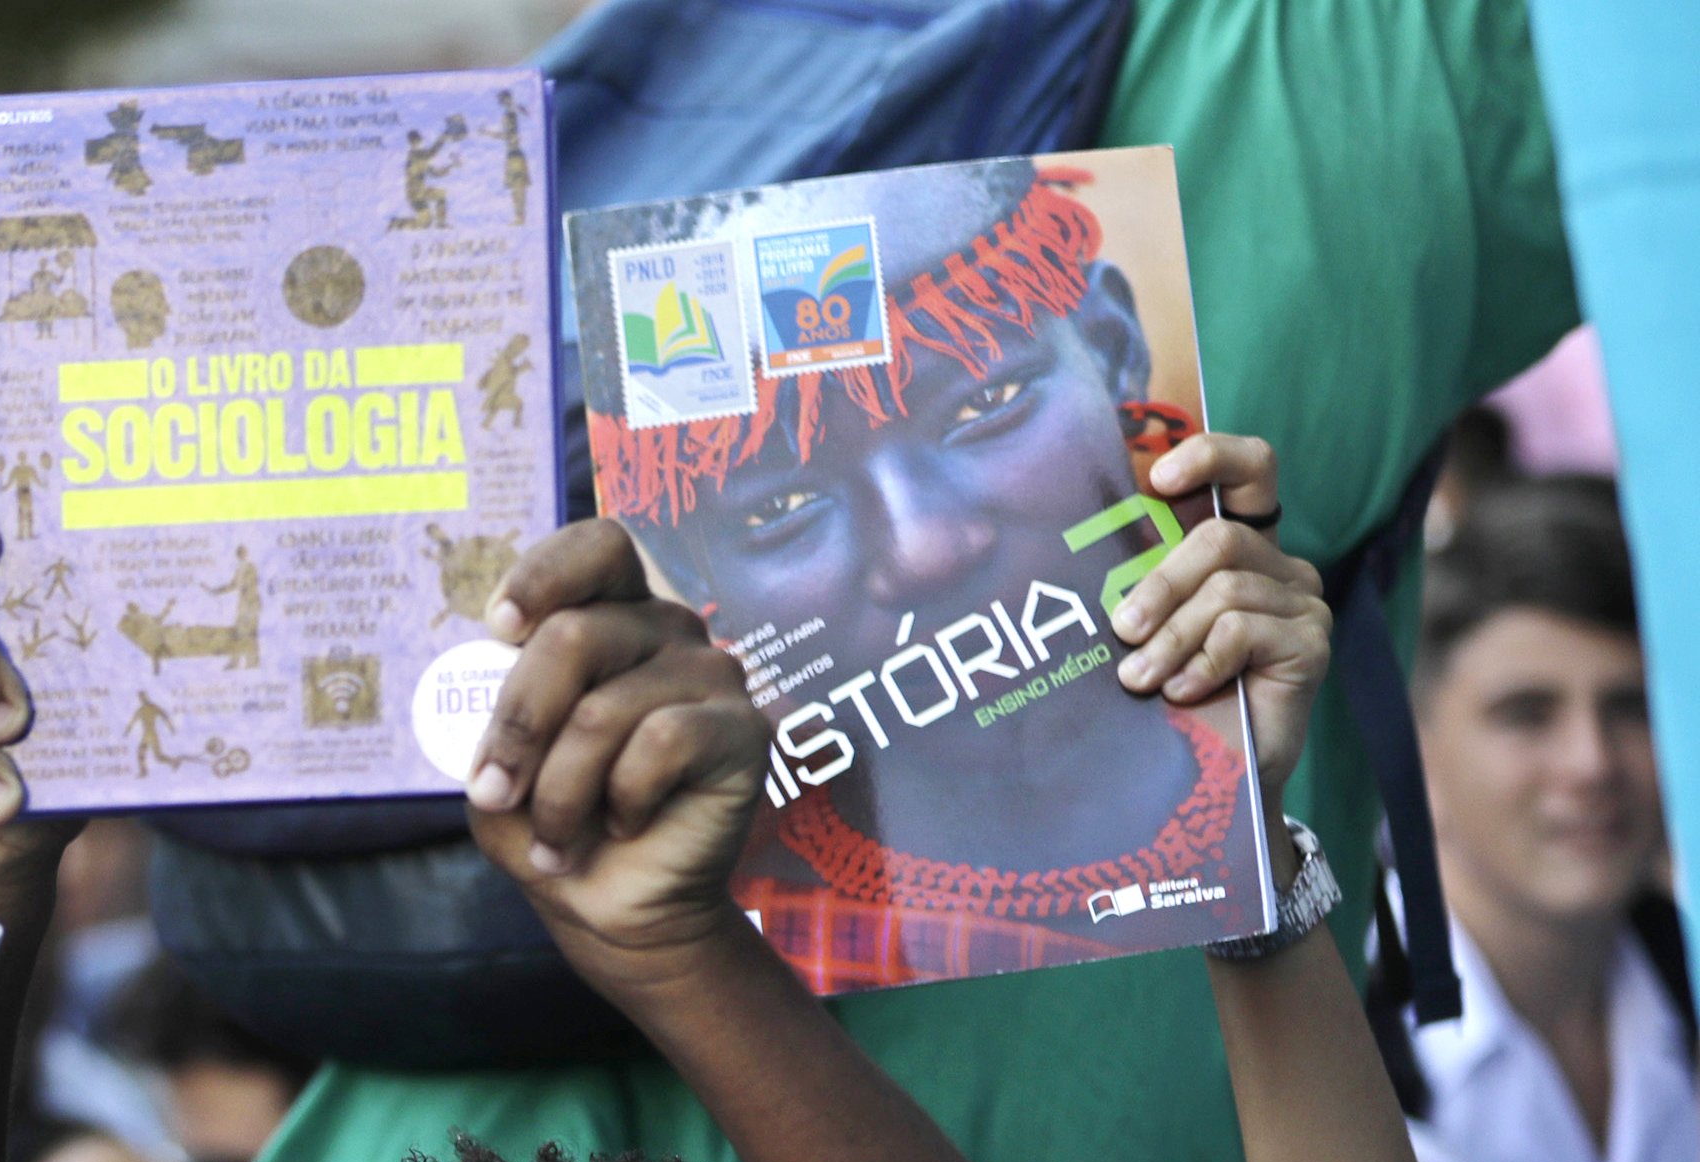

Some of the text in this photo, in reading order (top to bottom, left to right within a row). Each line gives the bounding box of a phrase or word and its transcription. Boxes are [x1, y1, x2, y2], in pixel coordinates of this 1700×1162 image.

[625, 257, 676, 282] PNLD
[796, 294, 851, 330] 80
[799, 325, 851, 343] ANOS
[150, 347, 352, 399] O LIVRO DA
[60, 388, 468, 484] SOCIOLOGIA
[765, 580, 1098, 809] ISTÓRIA
[972, 643, 1112, 729] ENSINO MÉDIO
[1149, 877, 1199, 895] Editora
[1150, 886, 1227, 910] Saraiva
